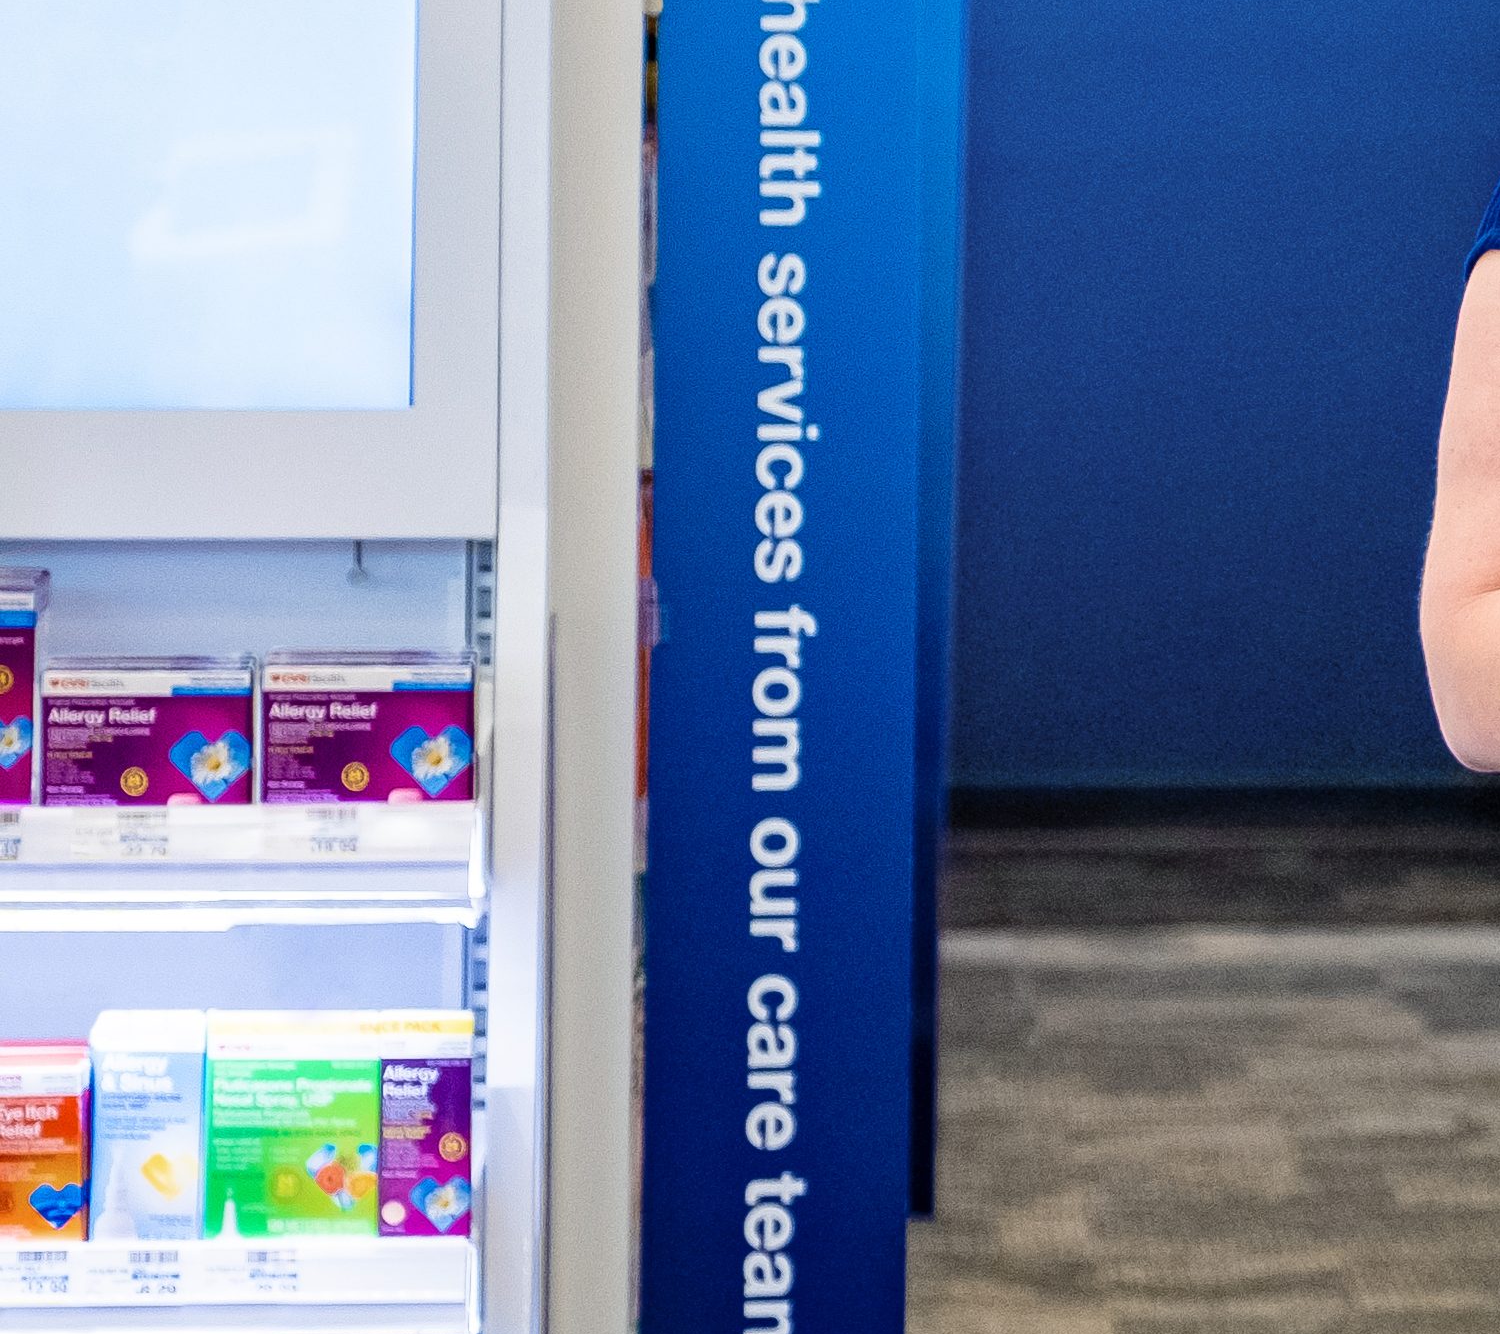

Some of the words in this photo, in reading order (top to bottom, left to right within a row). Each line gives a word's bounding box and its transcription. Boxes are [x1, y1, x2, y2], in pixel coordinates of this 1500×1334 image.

[753, 252, 821, 584] services
[48, 706, 106, 727] Allergy
[108, 706, 157, 725] Relief
[269, 701, 327, 723] Allergy
[329, 701, 379, 720] Relief
[750, 605, 819, 792] from
[748, 817, 801, 953] our
[744, 972, 799, 1153] care
